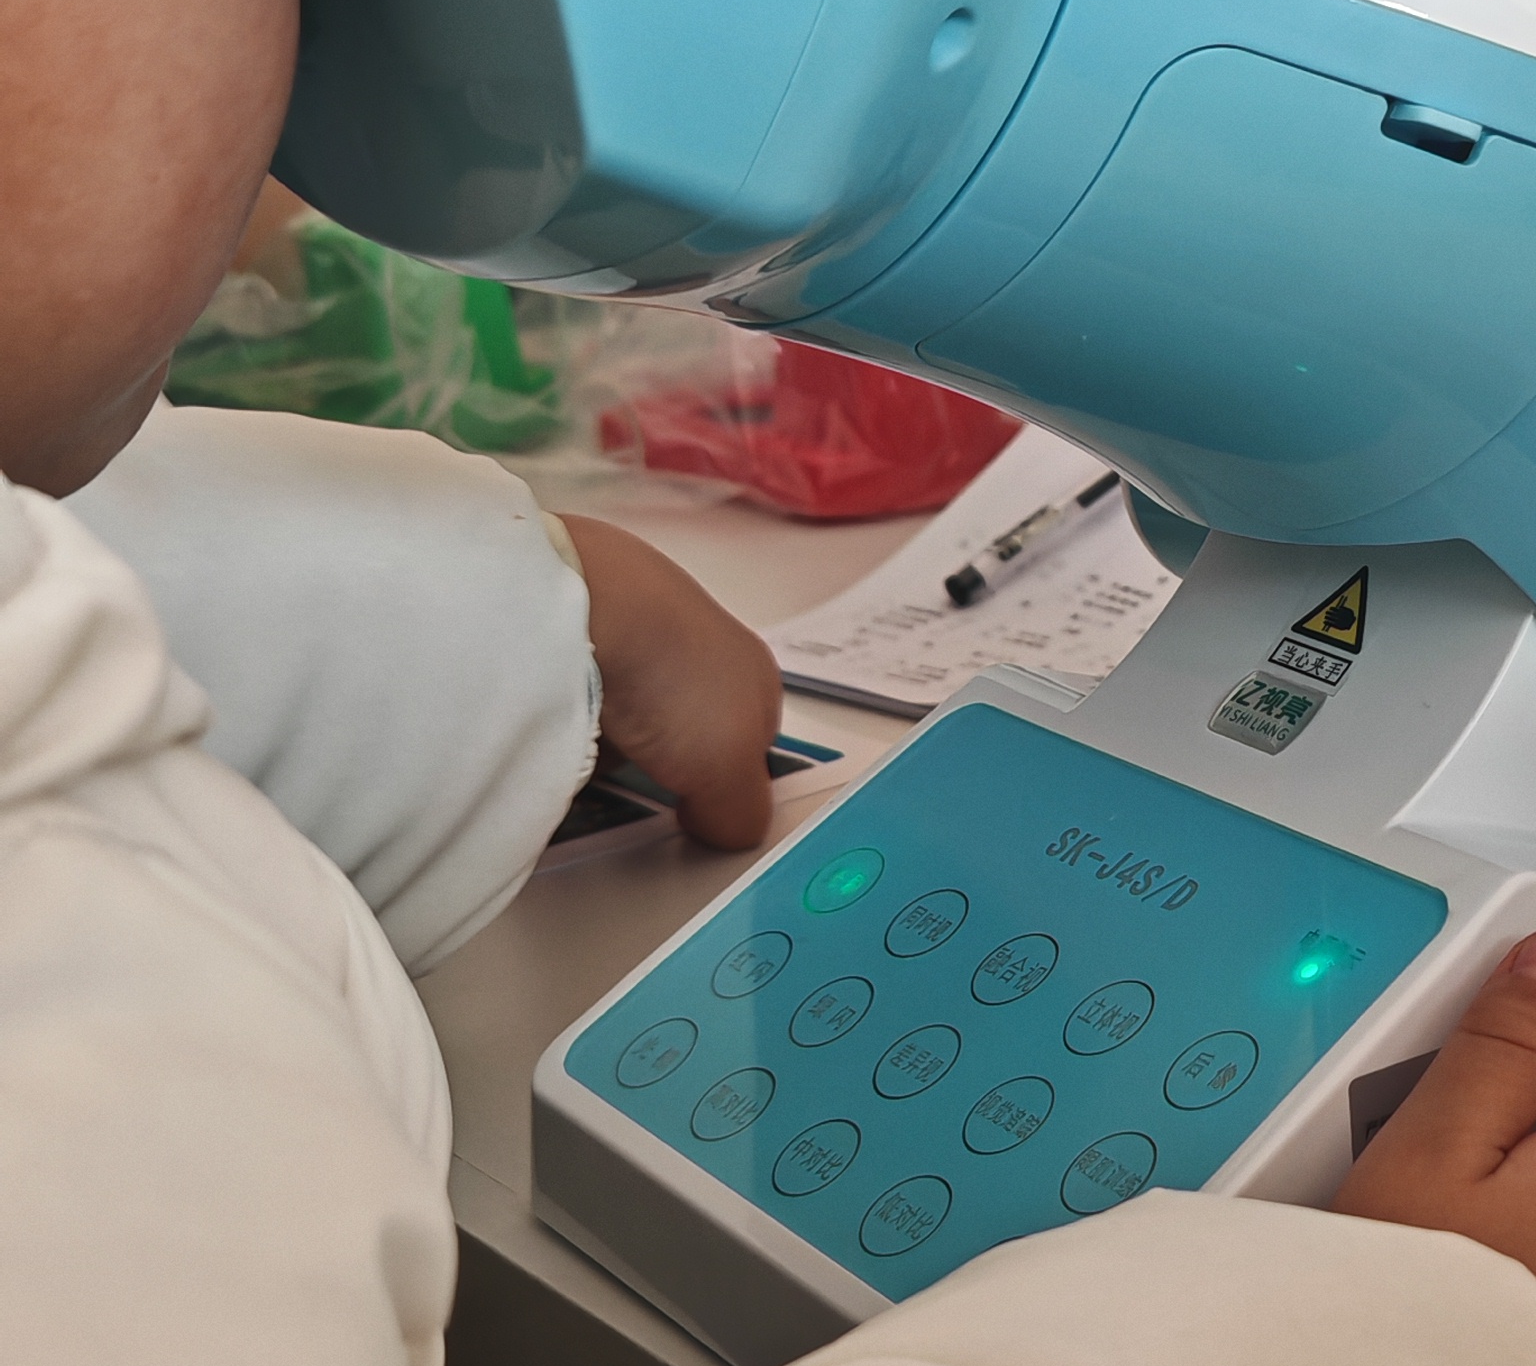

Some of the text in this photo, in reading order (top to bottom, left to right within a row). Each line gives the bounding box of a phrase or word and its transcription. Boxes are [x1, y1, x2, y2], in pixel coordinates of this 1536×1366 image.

[1277, 645, 1343, 679] 当心夹手
[1231, 679, 1313, 725] 亿视亮
[1250, 717, 1289, 741] LIANG
[1045, 827, 1199, 911] SK-J4S/D
[899, 905, 953, 942] 同时视
[1077, 998, 1140, 1040] 立体视
[790, 1137, 844, 1181] 中对比
[874, 1192, 935, 1241] 低对比
